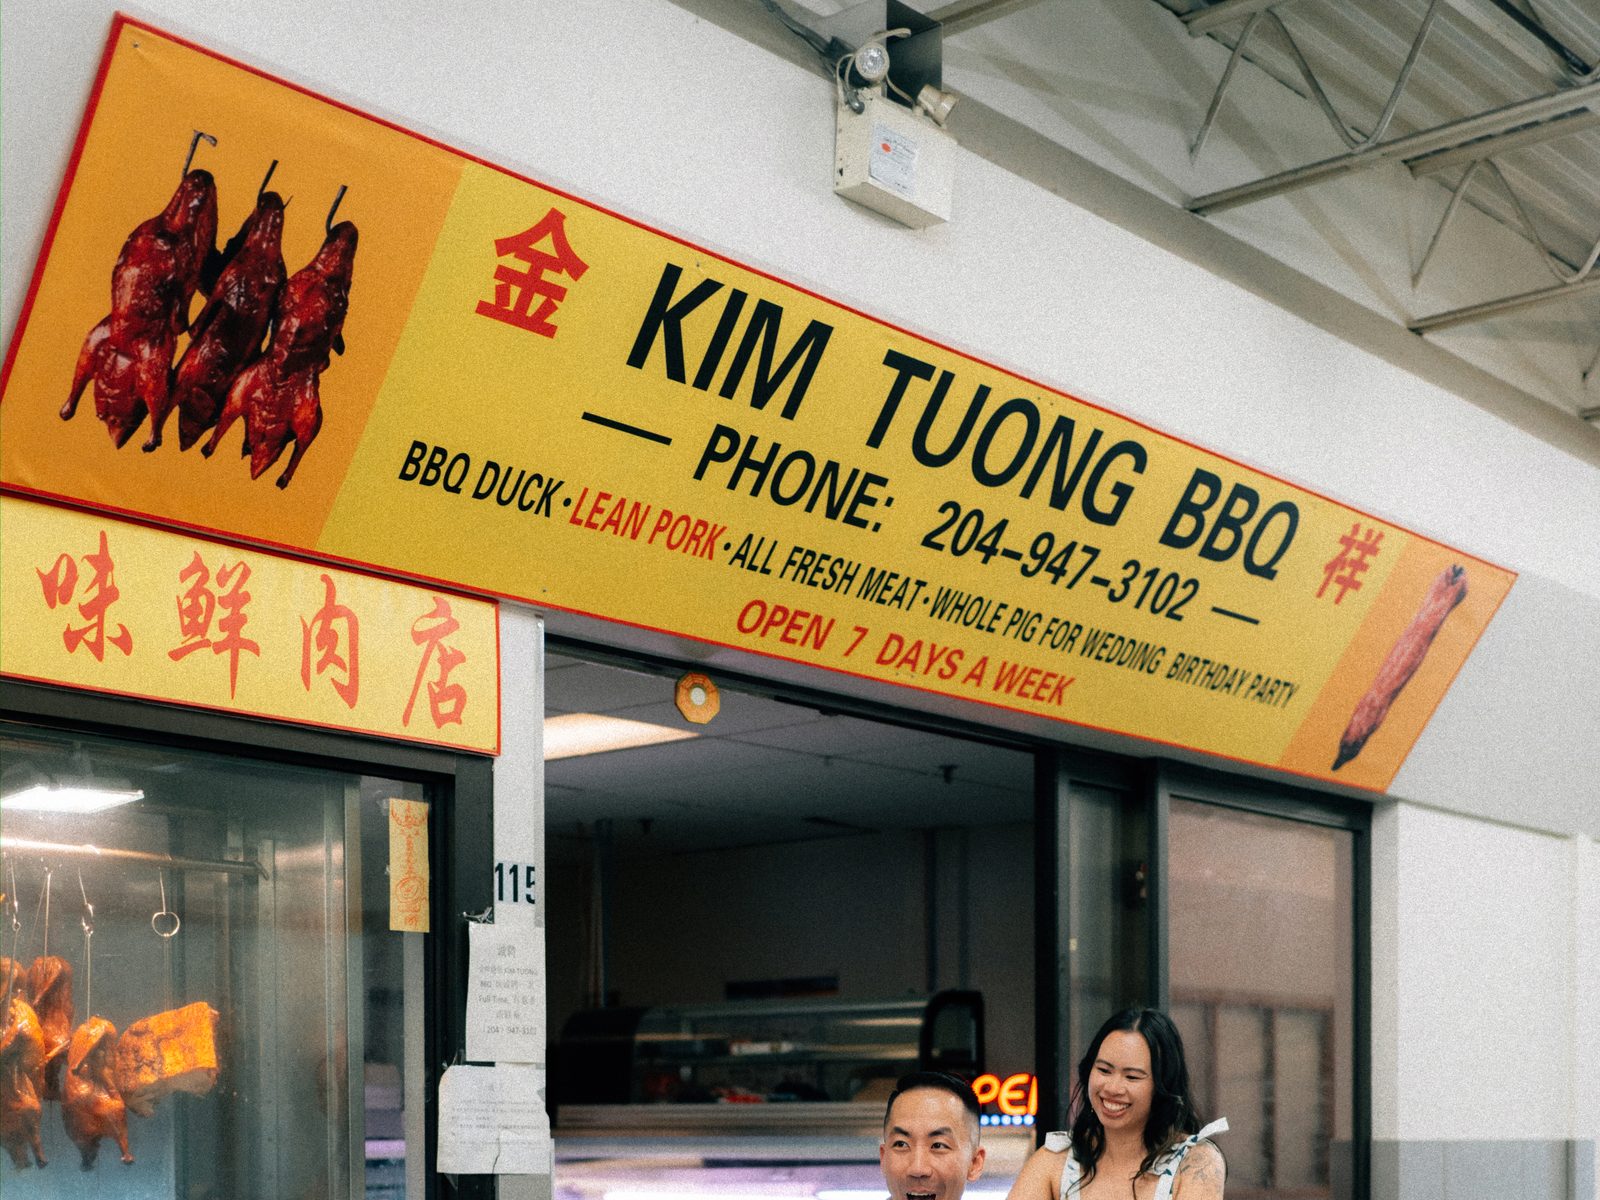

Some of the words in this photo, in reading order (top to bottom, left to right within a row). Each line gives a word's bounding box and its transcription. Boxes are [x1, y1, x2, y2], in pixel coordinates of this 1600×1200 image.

[475, 207, 589, 339] 金
[626, 263, 834, 421] KIM
[865, 349, 1147, 526] TUONG
[1158, 467, 1301, 581] BBQ
[398, 439, 470, 495] BBQ
[471, 460, 566, 518] DUCK
[569, 487, 652, 541] LEAN
[647, 508, 728, 561] PORK
[728, 533, 778, 575] ALL
[779, 545, 861, 595] FRESH
[856, 566, 928, 611] MEAT
[929, 586, 1009, 633] WHOLE
[1002, 607, 1043, 642] PIG
[1038, 617, 1083, 653] FOR
[1079, 628, 1166, 675] WEDDING
[1165, 652, 1252, 699] BIRTHDAY
[1244, 674, 1300, 709] PARTY
[693, 423, 894, 533] PHONE:
[921, 500, 1199, 622] 204-947-3102
[1316, 523, 1385, 605] 祥
[736, 599, 836, 651] OPEN
[843, 625, 869, 657] 7
[875, 632, 965, 680] DAYS
[961, 655, 989, 687] A
[992, 660, 1077, 706] WEEK
[495, 863, 536, 904] 115
